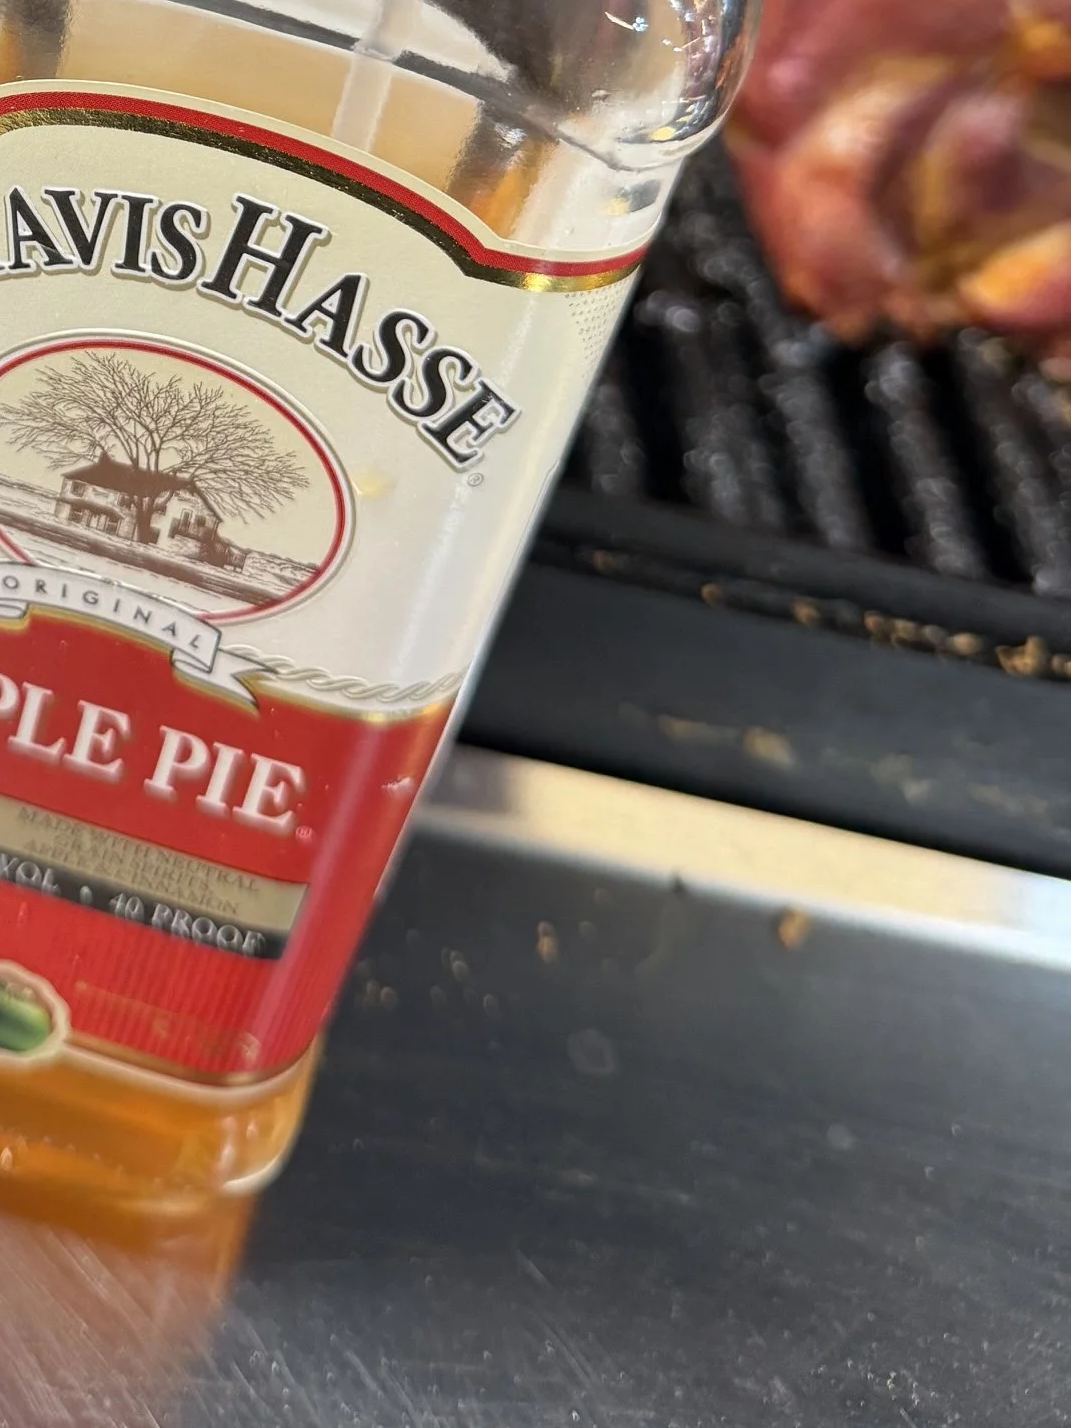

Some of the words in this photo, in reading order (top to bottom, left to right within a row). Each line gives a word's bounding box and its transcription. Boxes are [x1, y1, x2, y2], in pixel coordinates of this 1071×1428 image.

[202, 193, 522, 473] HASSE
[2, 575, 202, 649] ORIGINAL
[143, 725, 306, 838] PIE
[109, 892, 145, 921] 40
[151, 903, 266, 956] PROOF
